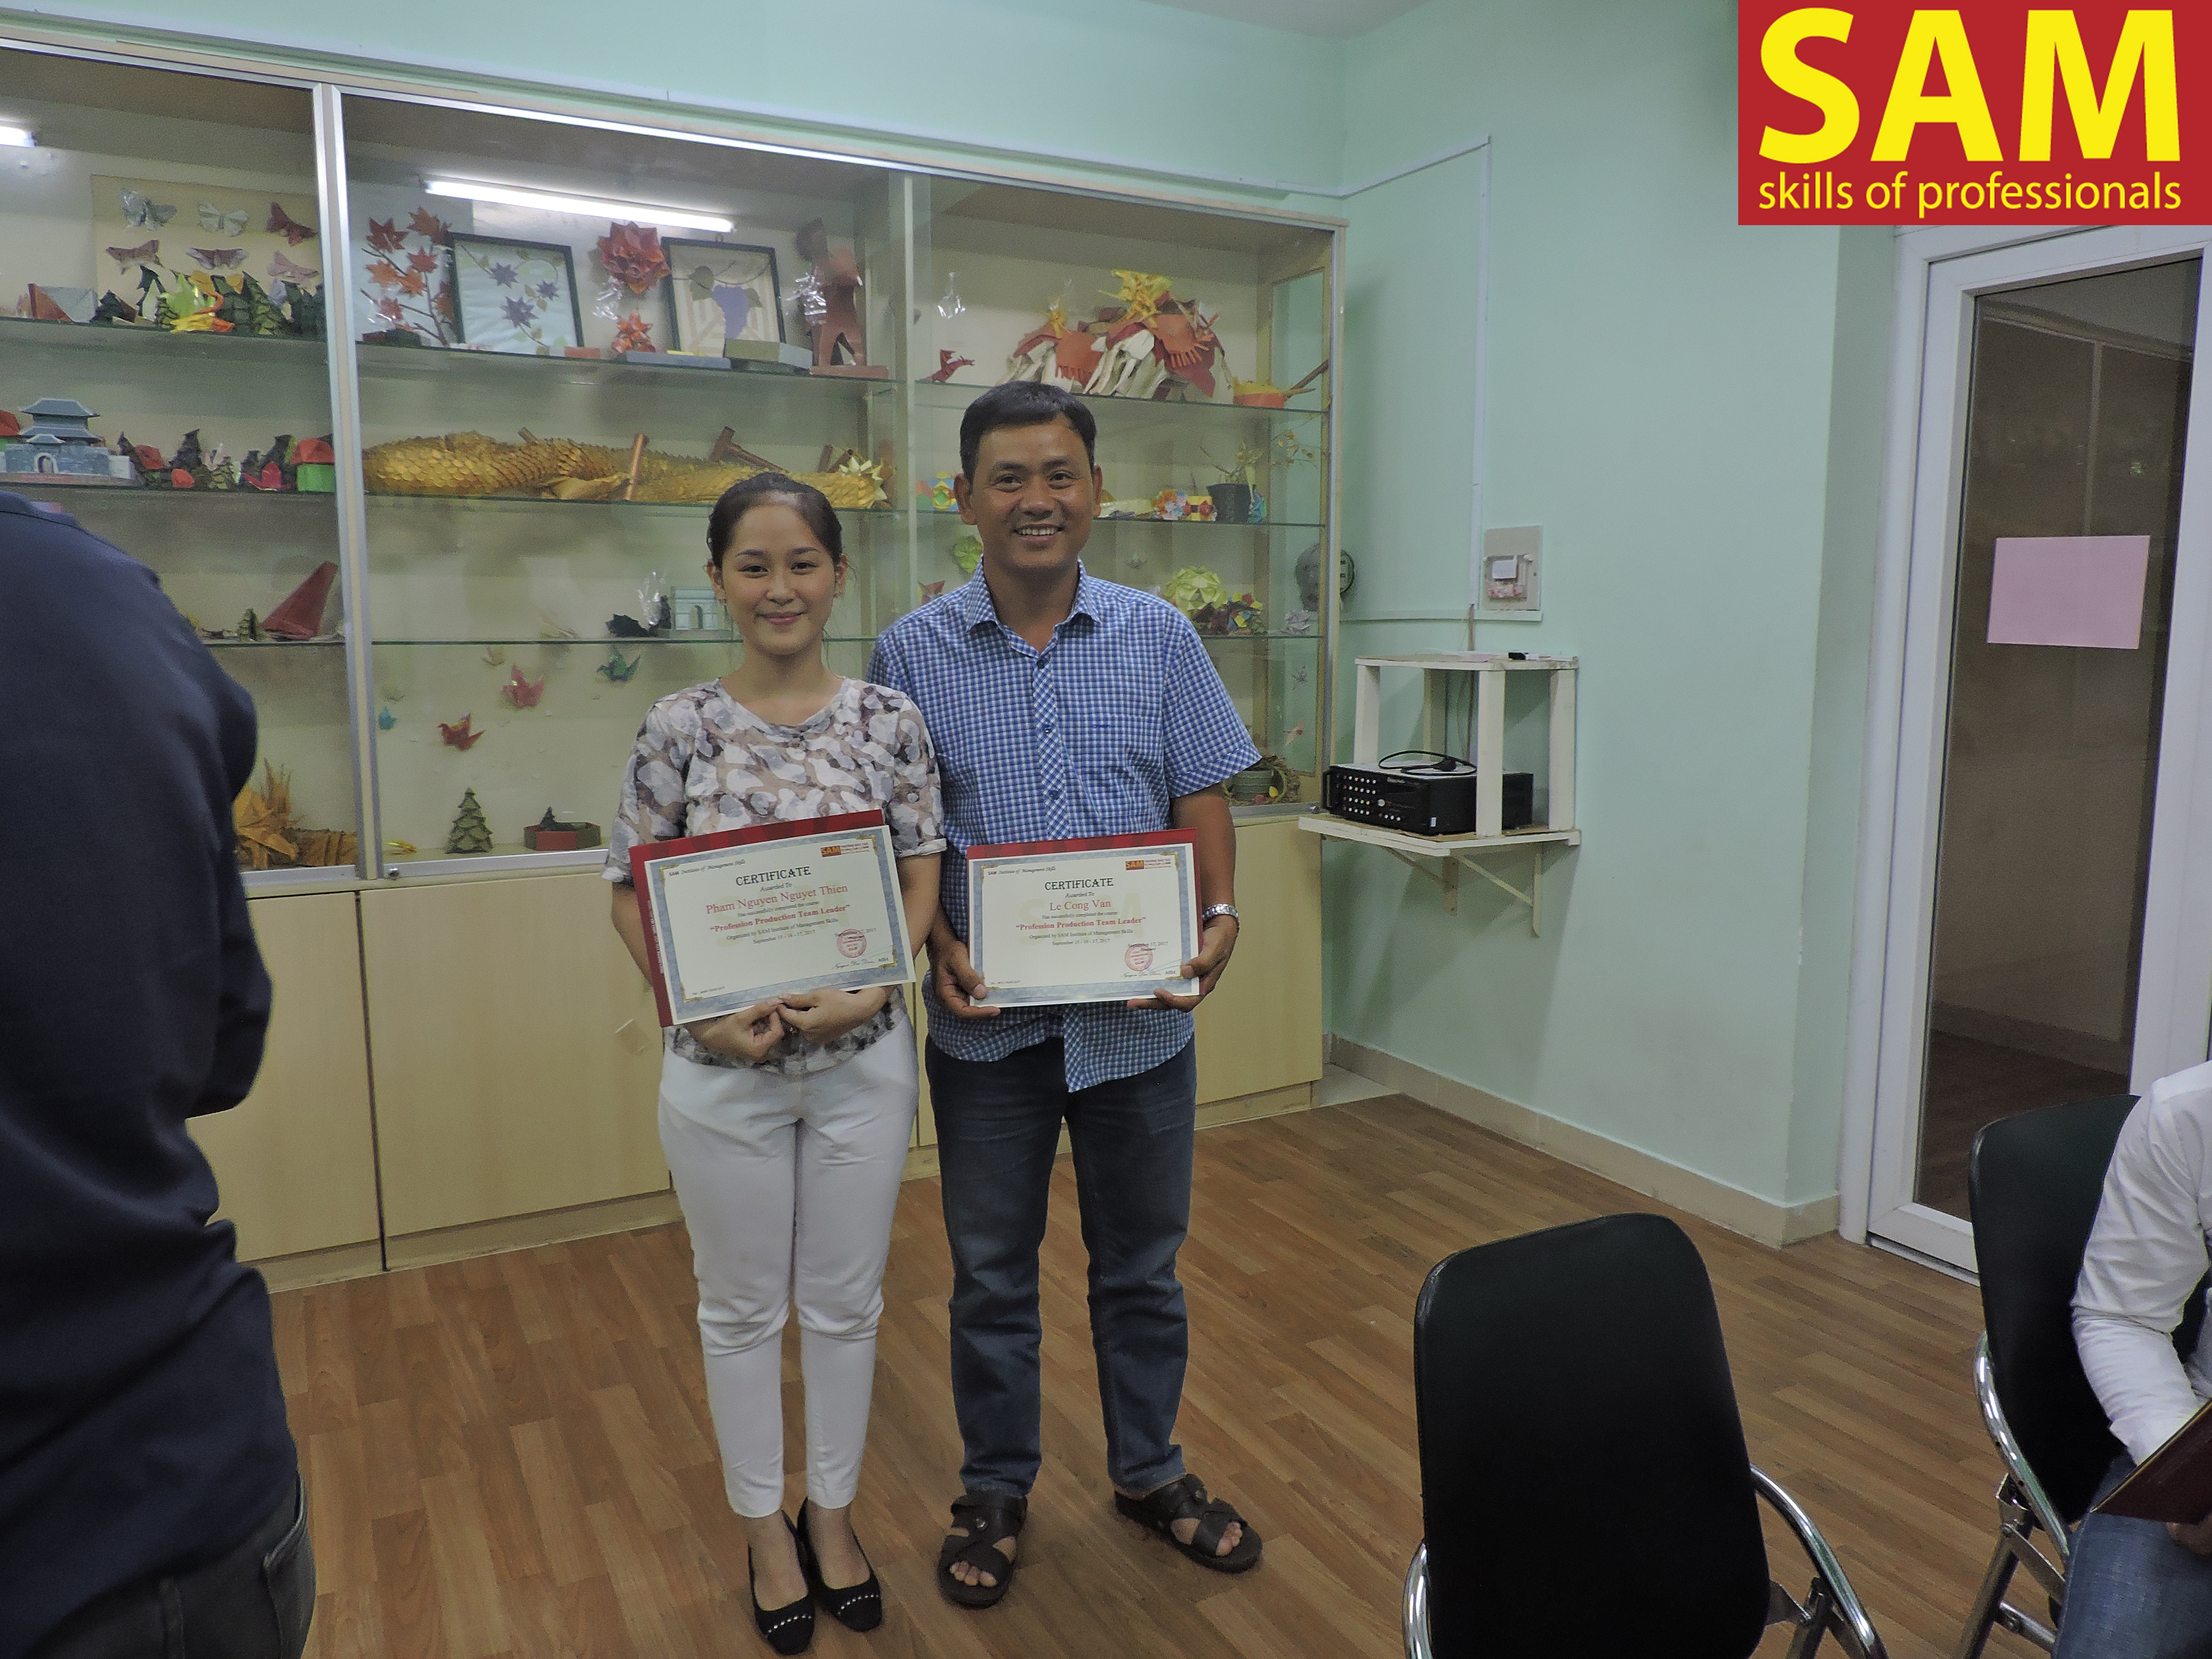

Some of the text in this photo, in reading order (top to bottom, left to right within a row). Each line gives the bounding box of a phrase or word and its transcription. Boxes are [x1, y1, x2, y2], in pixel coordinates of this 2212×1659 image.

[1126, 860, 1143, 868] SAM
[735, 866, 811, 886] CERTIFICATE
[1045, 878, 1114, 890] CERTIFICATE
[706, 885, 848, 914] Pham Nguyen Nguyet Thien
[1050, 900, 1111, 911] Le Cong Van
[755, 914, 796, 925] Production
